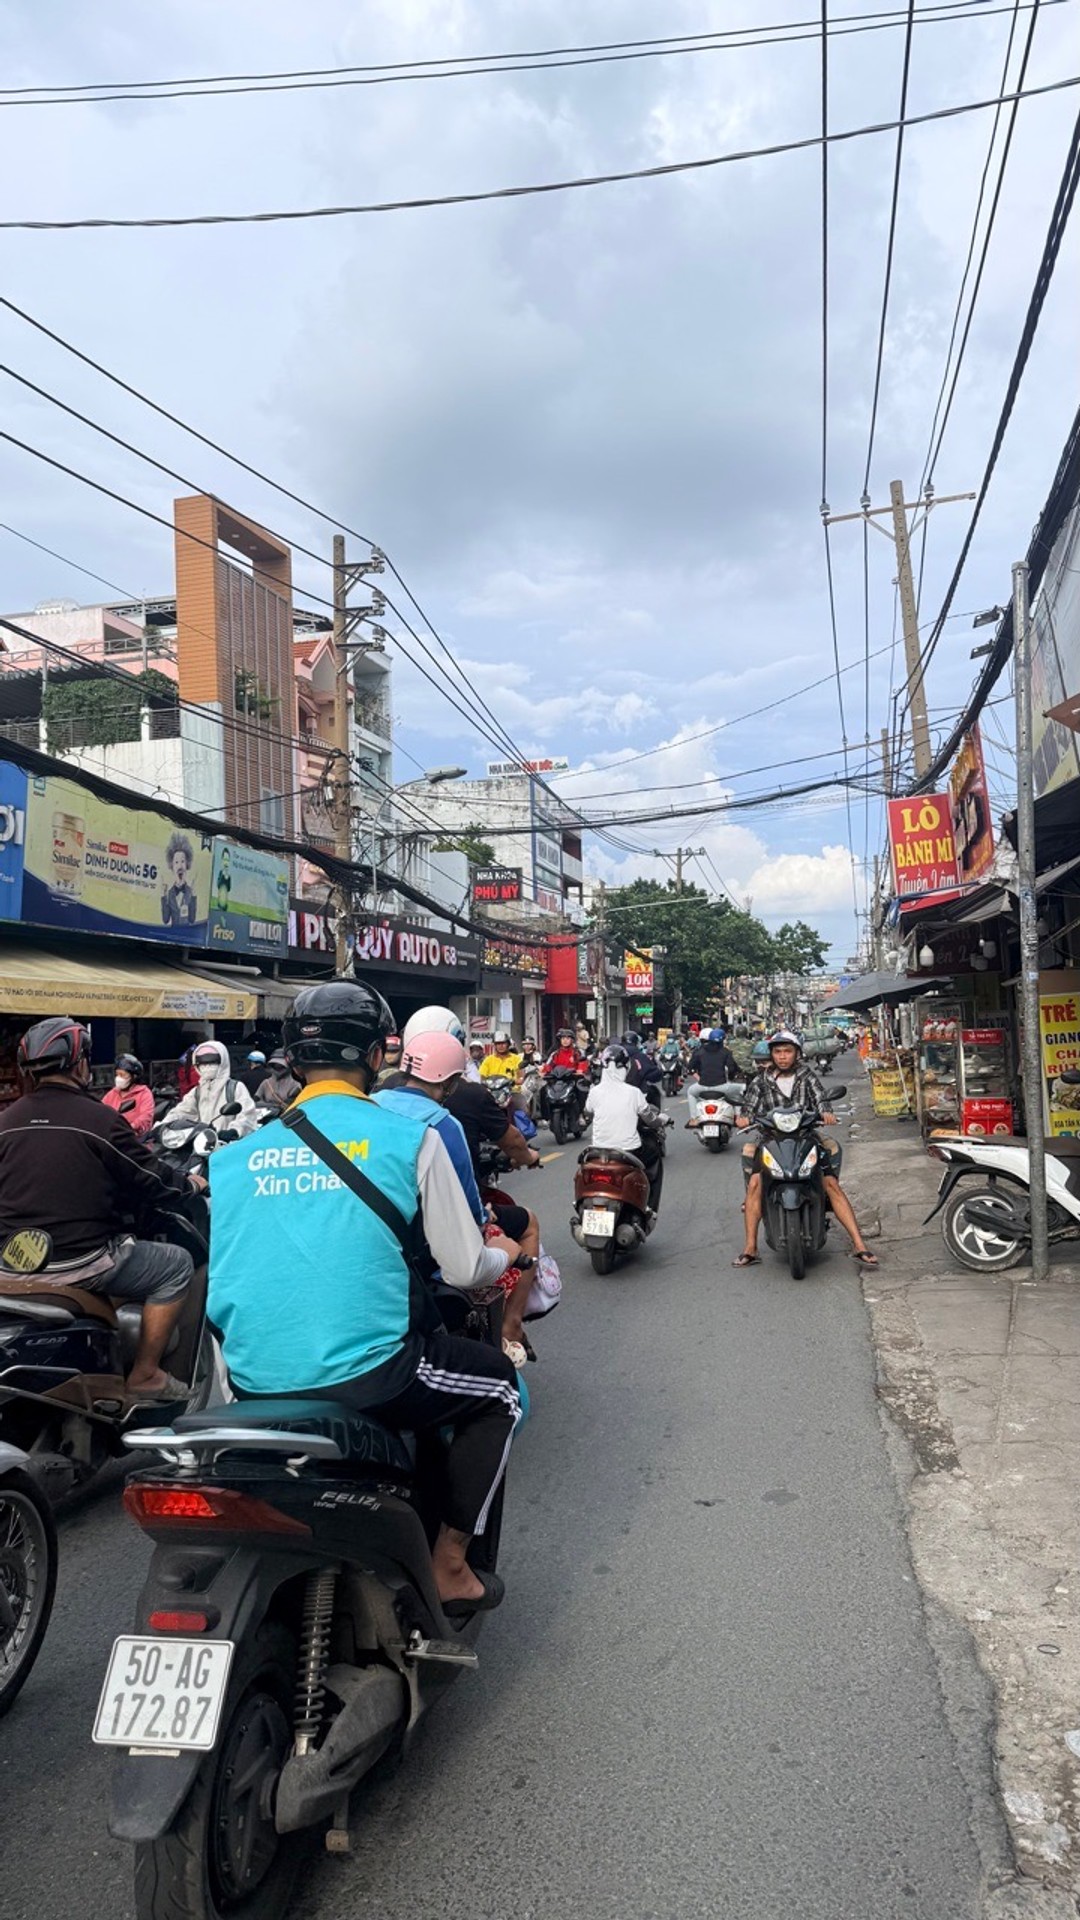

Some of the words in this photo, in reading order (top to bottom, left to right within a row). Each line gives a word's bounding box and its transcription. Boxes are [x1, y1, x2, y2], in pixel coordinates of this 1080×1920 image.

[901, 799, 940, 833] LÒ
[53, 850, 80, 868] Similac
[895, 835, 934, 868] BÁNH
[936, 830, 954, 862] MÌ
[85, 853, 109, 869] DINH
[142, 863, 158, 880] 5G
[476, 871, 493, 880] NHA
[475, 881, 498, 900] PHÚ
[213, 924, 236, 941] Friso
[398, 931, 441, 966] AUTO
[443, 945, 458, 966] 68
[626, 973, 651, 985] 10K
[1041, 1000, 1077, 1023] TRÉ
[253, 1174, 290, 1197] Xin
[25, 1336, 68, 1346] LEAD
[321, 1491, 377, 1506] FELIZ
[125, 1645, 213, 1689] 50-AG
[111, 1692, 213, 1740] 172.87
